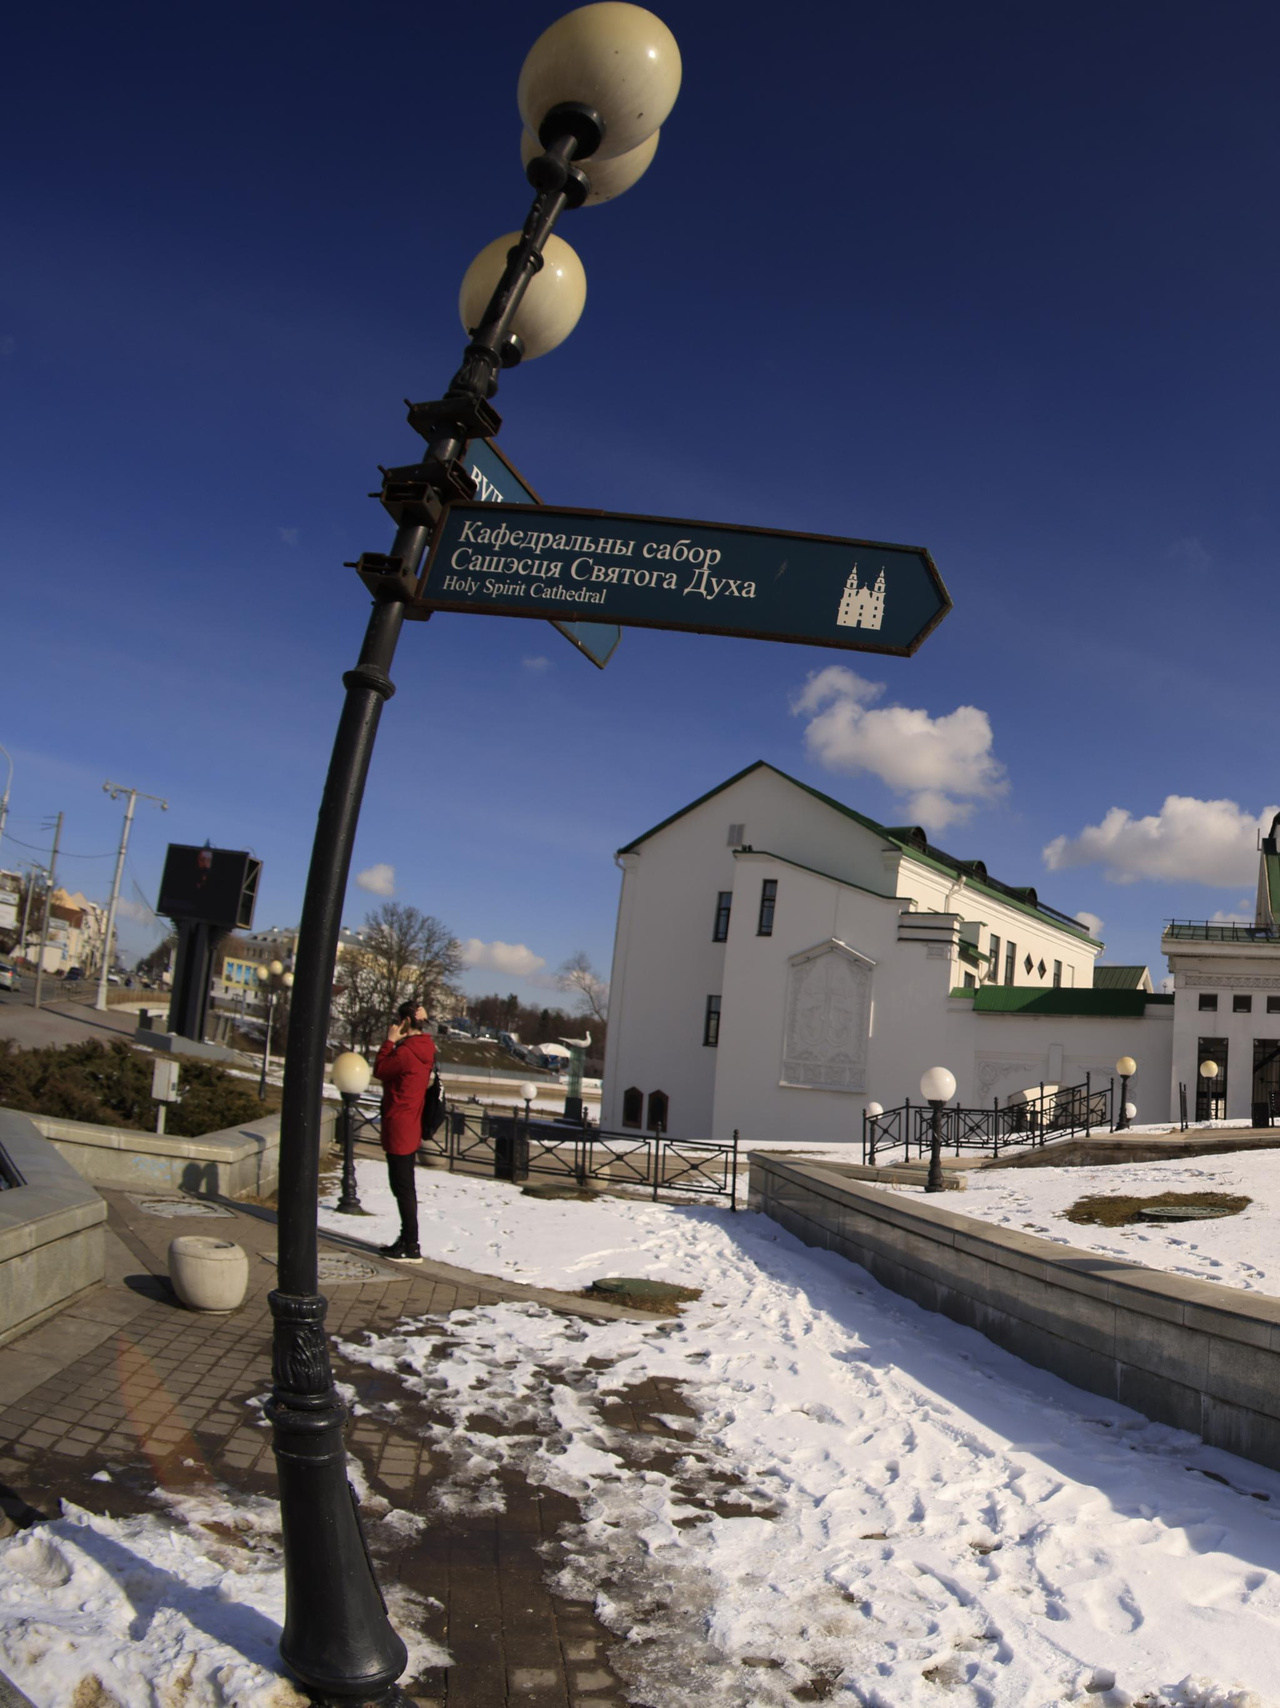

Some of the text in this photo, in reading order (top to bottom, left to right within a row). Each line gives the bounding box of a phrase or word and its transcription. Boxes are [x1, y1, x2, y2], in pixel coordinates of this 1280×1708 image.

[458, 520, 721, 571] Кафедральны сабор
[442, 575, 607, 604] Holy Spirit Cathedral
[451, 547, 757, 601] Сашэсця Святога Духа
